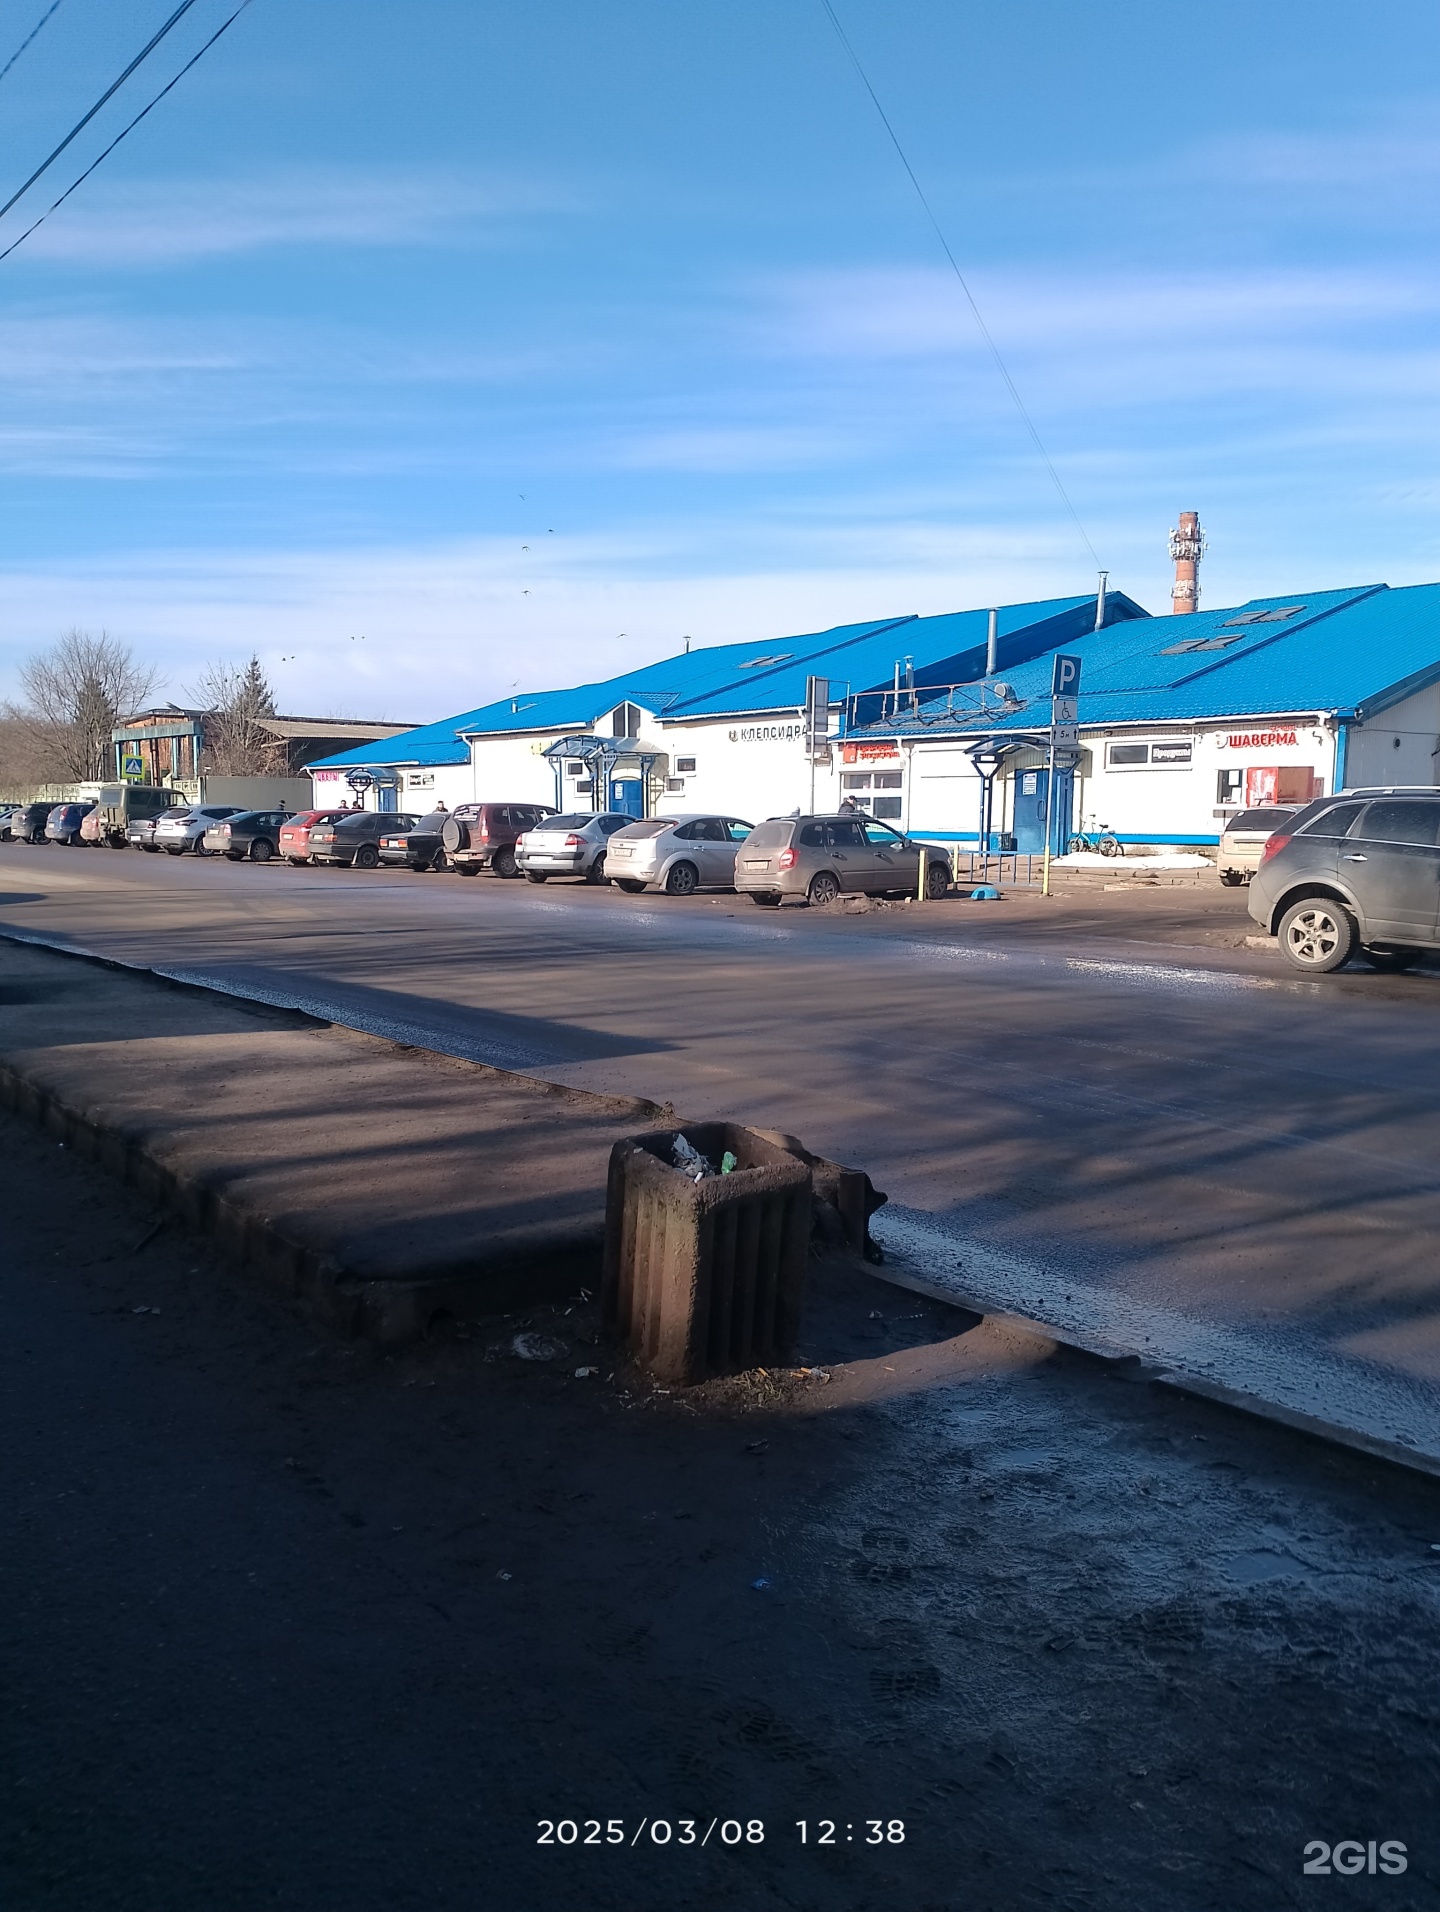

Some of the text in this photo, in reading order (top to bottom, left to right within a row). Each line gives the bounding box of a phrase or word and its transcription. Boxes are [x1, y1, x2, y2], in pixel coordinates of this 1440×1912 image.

[1060, 659, 1076, 691] P
[741, 725, 807, 740] КЛЕПСИДРА
[1229, 732, 1297, 747] ШАВЕРМА
